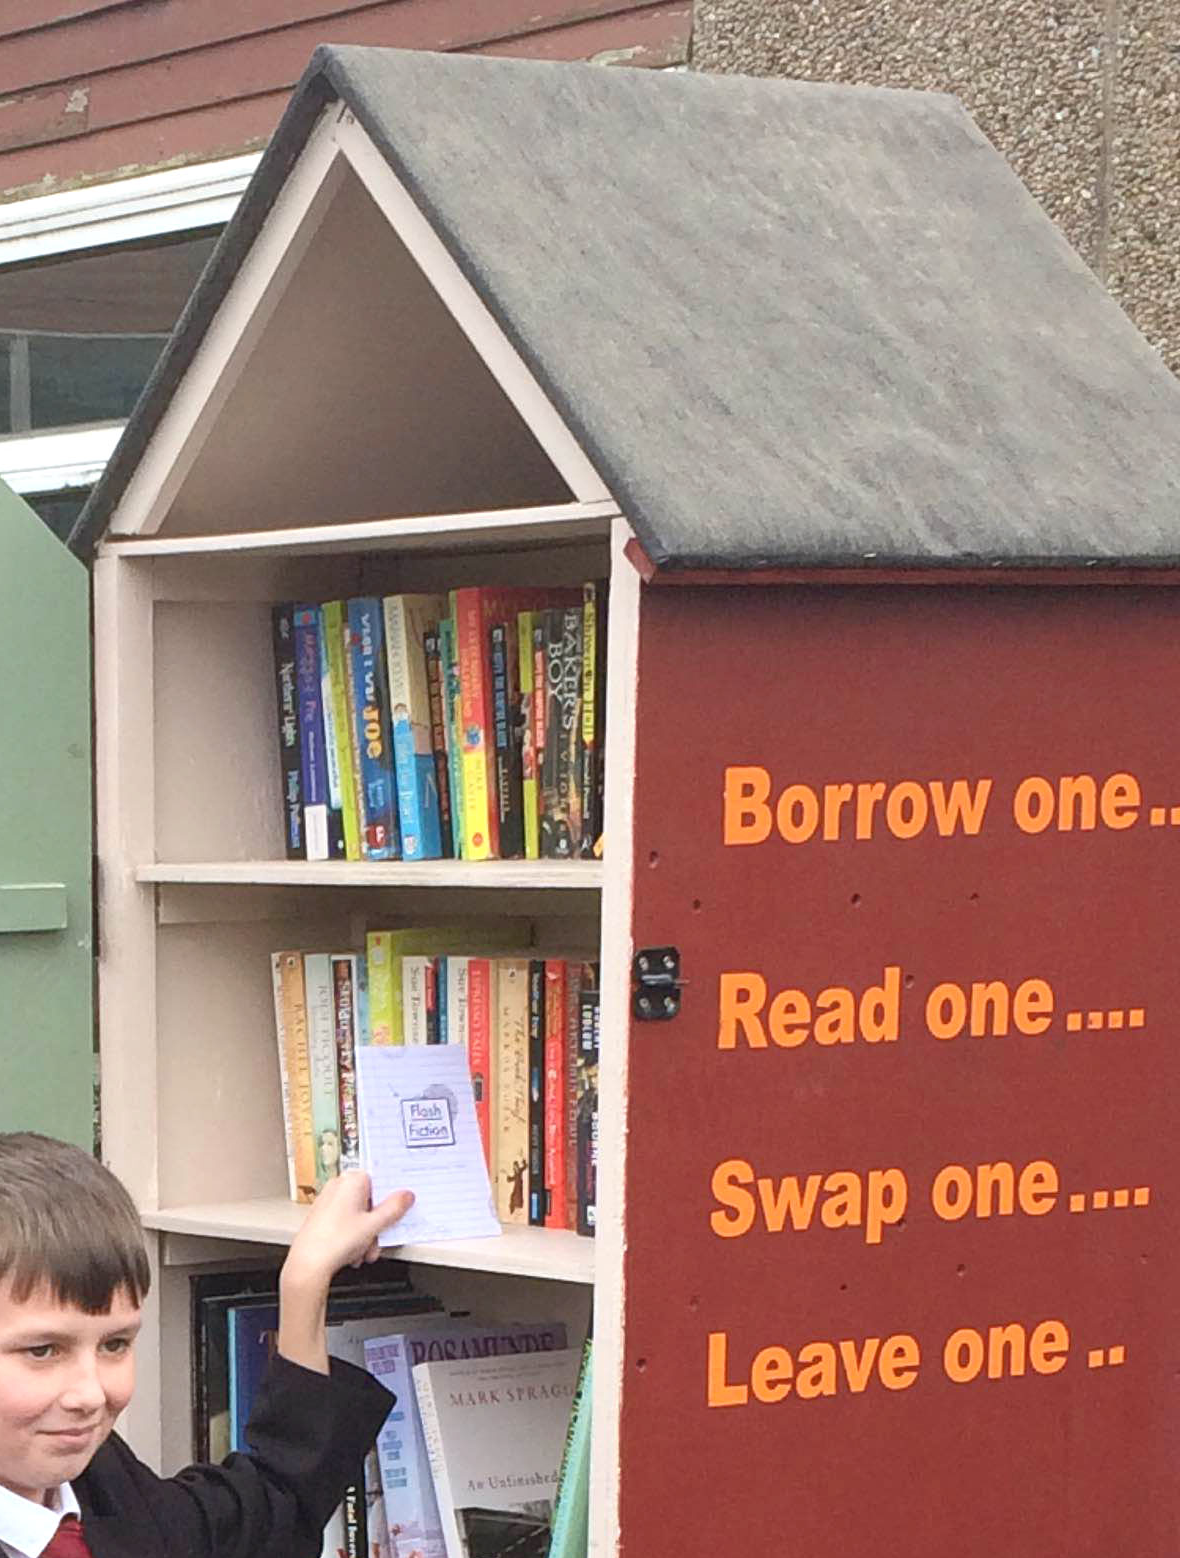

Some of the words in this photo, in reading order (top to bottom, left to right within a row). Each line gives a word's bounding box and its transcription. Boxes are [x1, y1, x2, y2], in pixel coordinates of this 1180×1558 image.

[548, 642, 562, 703] BOY
[563, 614, 578, 731] BAKER'S
[723, 765, 993, 846] Borrow
[717, 966, 901, 1049] Read
[409, 1123, 449, 1138] Fiction
[410, 1103, 442, 1118] Flash
[710, 1160, 908, 1244] Swap
[451, 1389, 501, 1407] MARK
[707, 1332, 921, 1408] Leave
